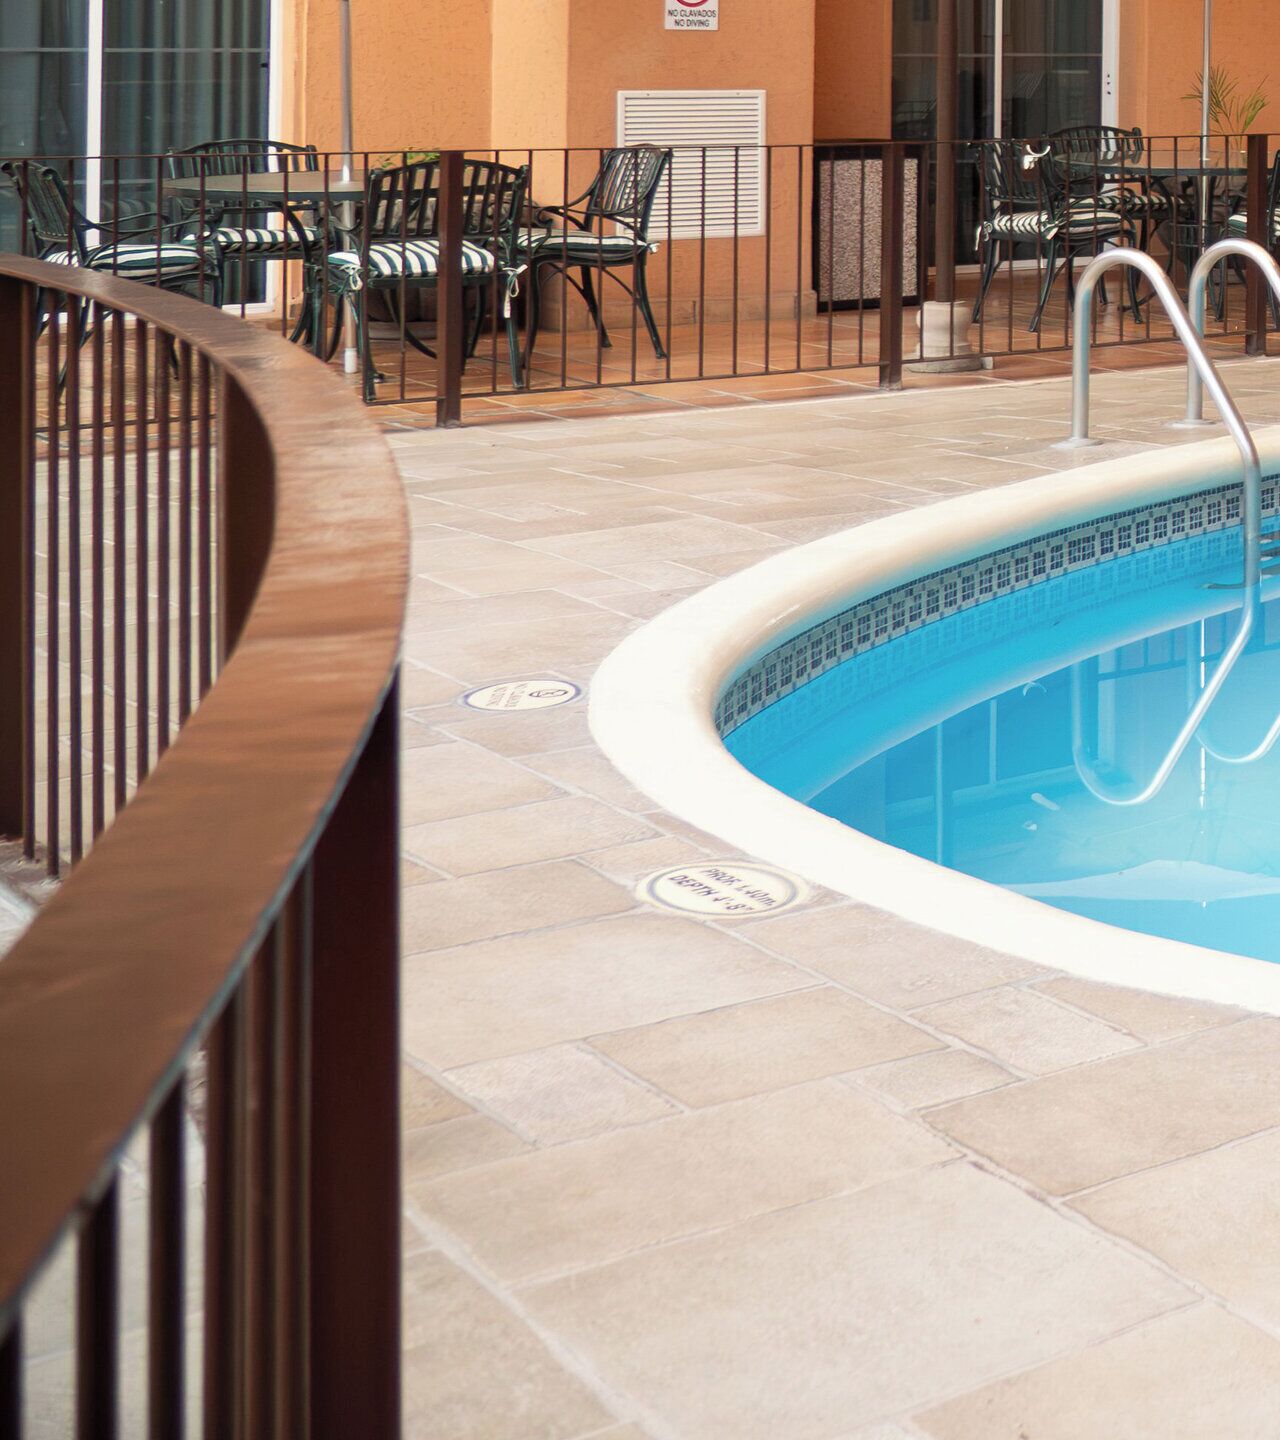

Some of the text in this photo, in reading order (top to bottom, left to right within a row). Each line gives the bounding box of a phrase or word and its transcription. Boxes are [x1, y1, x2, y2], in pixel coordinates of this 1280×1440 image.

[668, 9, 717, 18] NO CLAVADOS
[674, 19, 710, 28] NO DIVING
[668, 874, 720, 897] DEPTH
